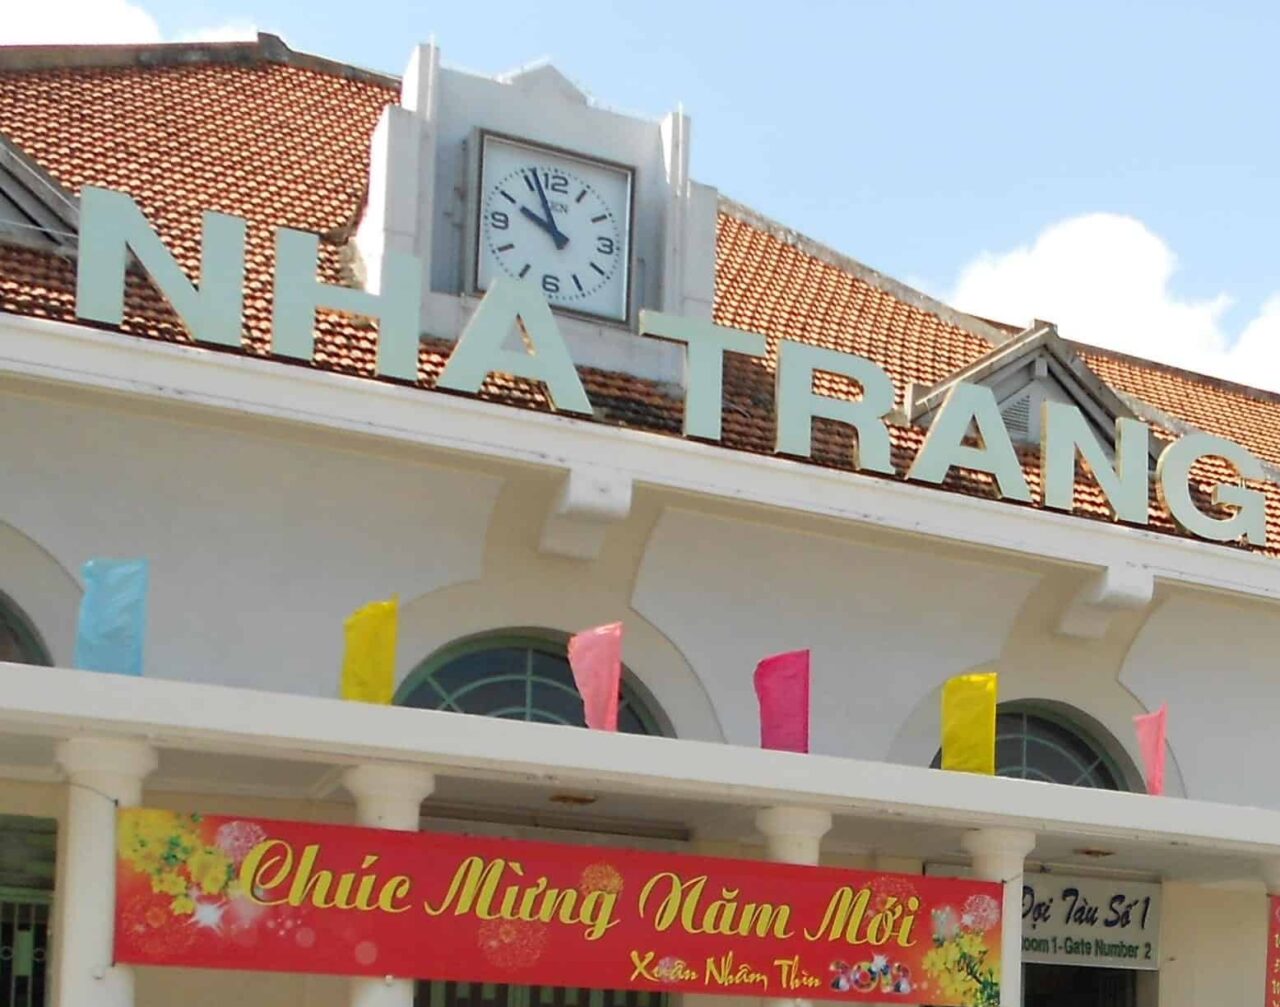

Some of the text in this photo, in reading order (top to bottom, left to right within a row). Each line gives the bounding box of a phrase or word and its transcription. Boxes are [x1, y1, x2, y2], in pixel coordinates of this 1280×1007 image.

[543, 171, 569, 194] 12
[491, 211, 509, 230] 9
[597, 236, 614, 255] 3
[542, 274, 560, 293] 6
[75, 185, 1267, 546] NHA TRANG
[239, 839, 920, 947] Chúc Mừng Năm Mới
[1062, 888, 1099, 926] Tàu
[1022, 935, 1049, 954] oom
[1095, 938, 1139, 959] Number
[1145, 942, 1152, 960] 2
[630, 949, 698, 983] Xuân
[704, 950, 768, 990] Nhâm
[828, 957, 913, 994] 2012
